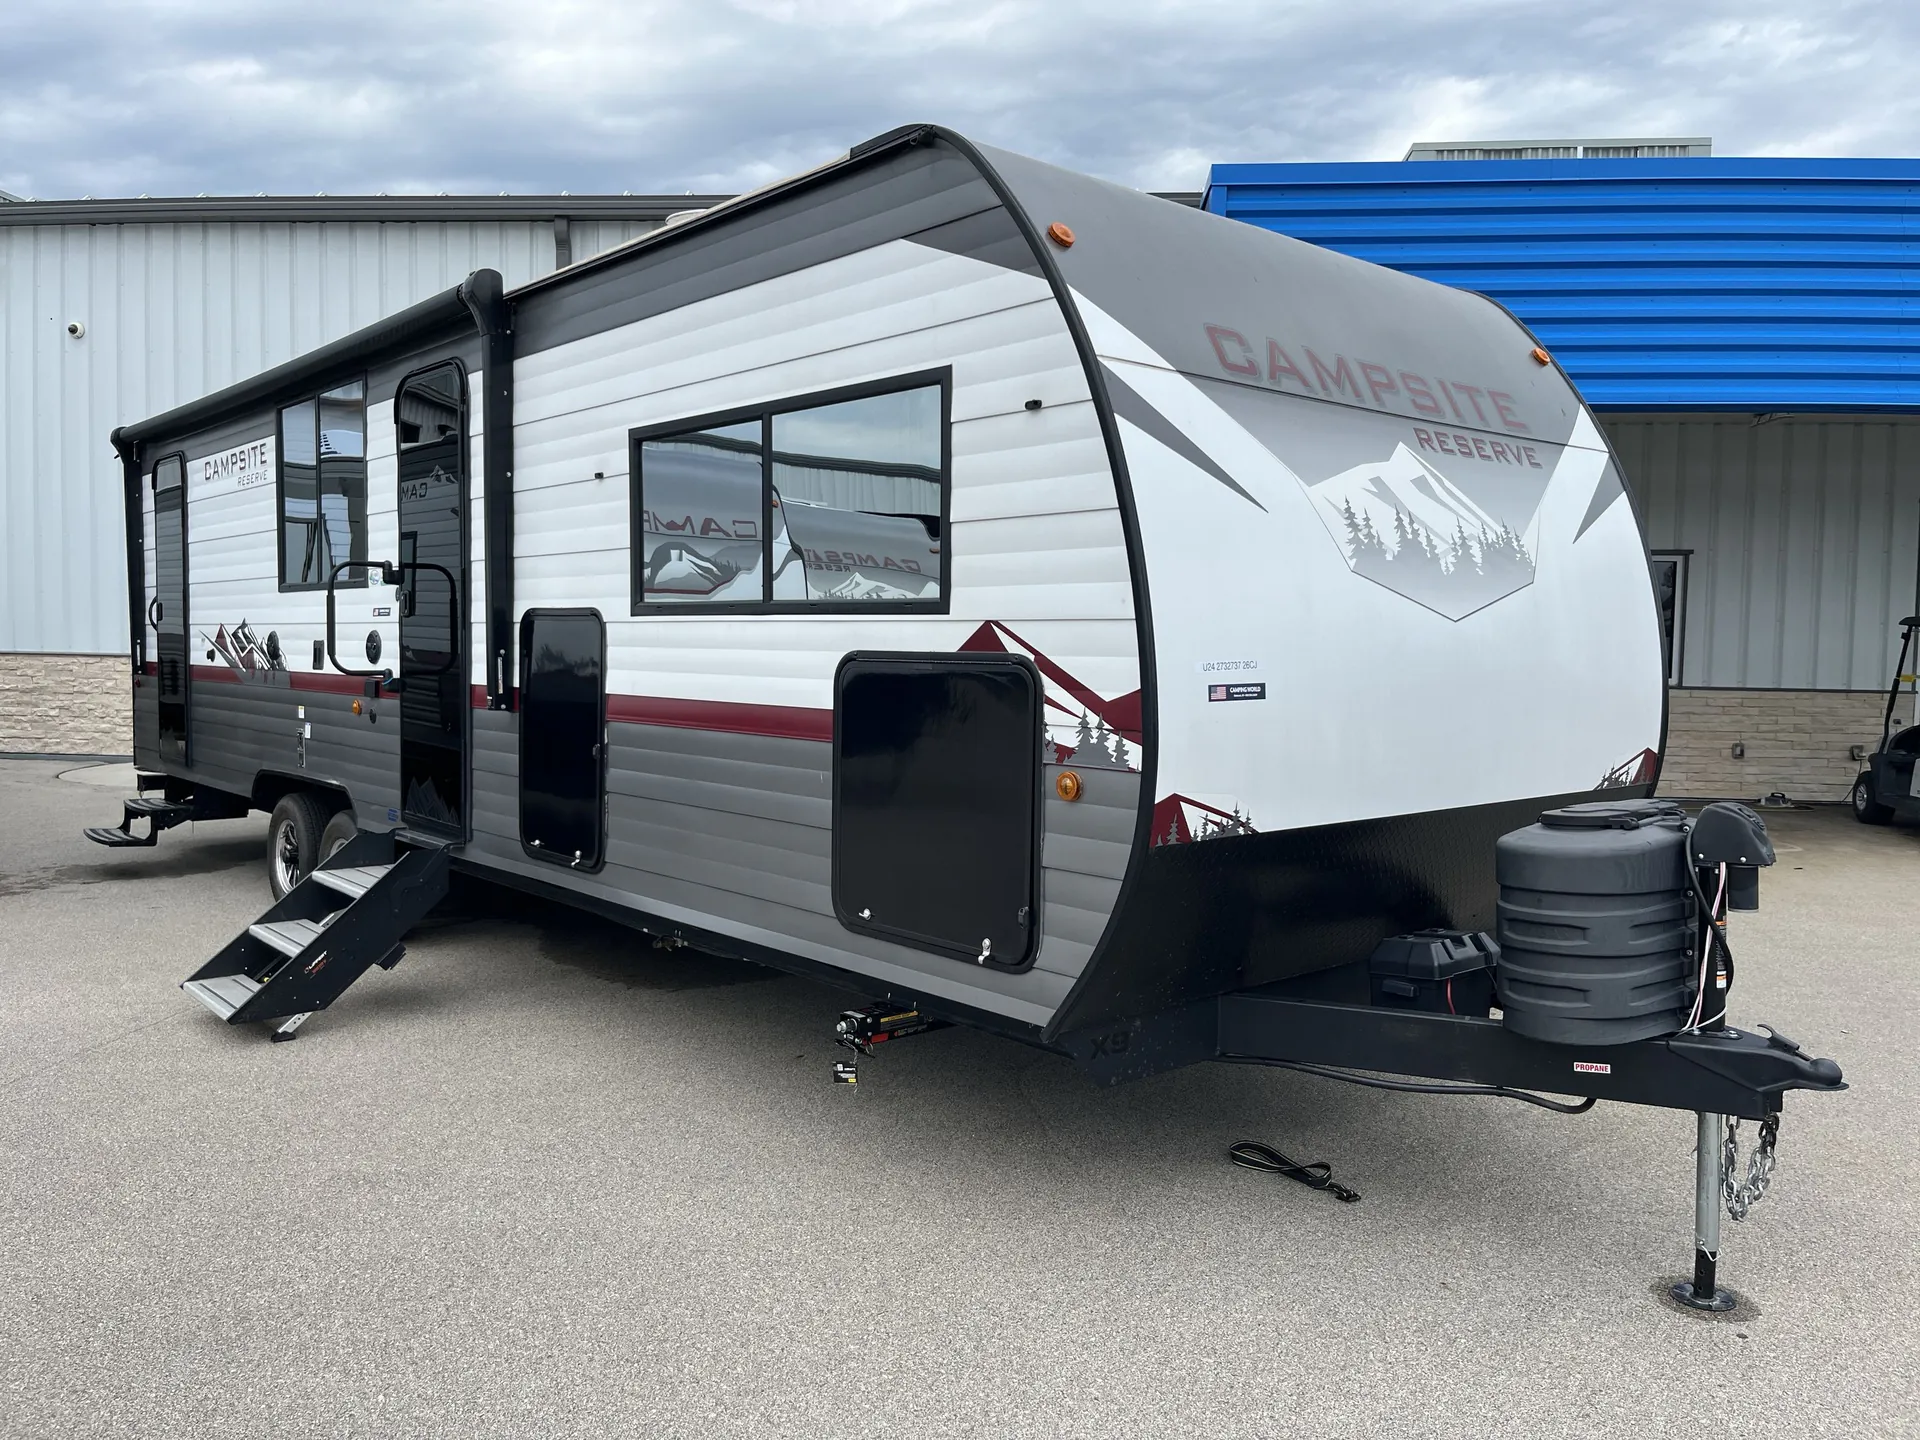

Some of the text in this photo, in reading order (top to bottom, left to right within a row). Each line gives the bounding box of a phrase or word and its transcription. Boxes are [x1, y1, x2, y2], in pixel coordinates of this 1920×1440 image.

[1203, 322, 1530, 431] CAMPSITE
[204, 442, 267, 481] CAMPSITE
[1413, 426, 1543, 469] RESERVE
[237, 469, 268, 487] RESERVE
[1202, 662, 1215, 671] U24
[1575, 1063, 1609, 1072] PROPANE
